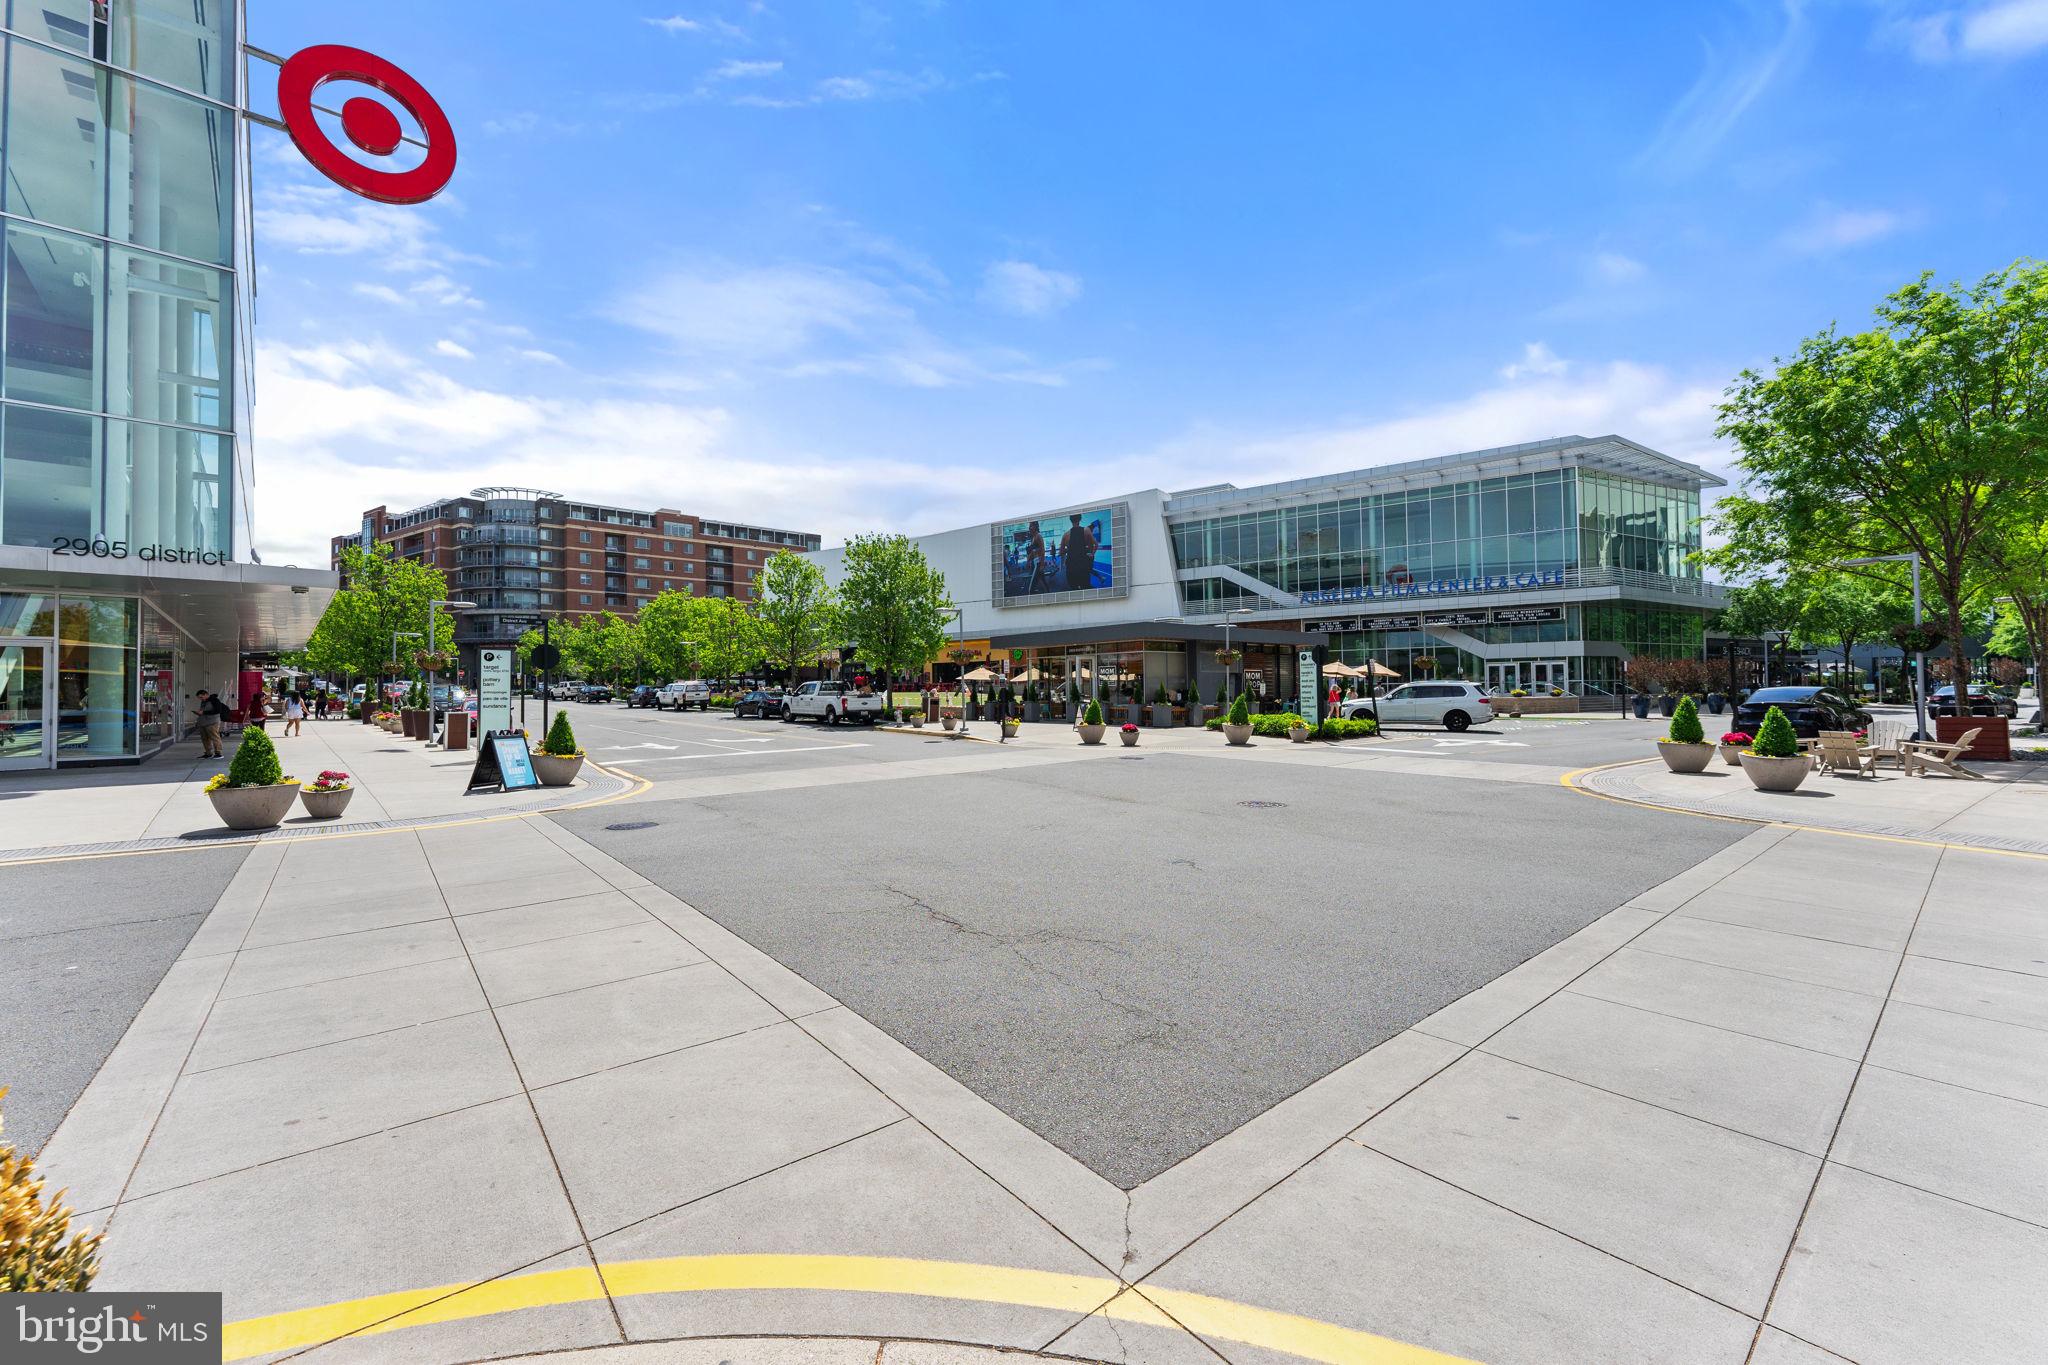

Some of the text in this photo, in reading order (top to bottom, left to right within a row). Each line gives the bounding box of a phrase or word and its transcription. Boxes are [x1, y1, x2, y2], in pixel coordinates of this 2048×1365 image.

[52, 536, 226, 567] 2905 district
[1300, 586, 1376, 604] ANGELIKA
[1381, 583, 1420, 598] FILM
[1427, 576, 1492, 594] CENTER
[1497, 575, 1509, 590] &
[1245, 672, 1261, 680] MOM
